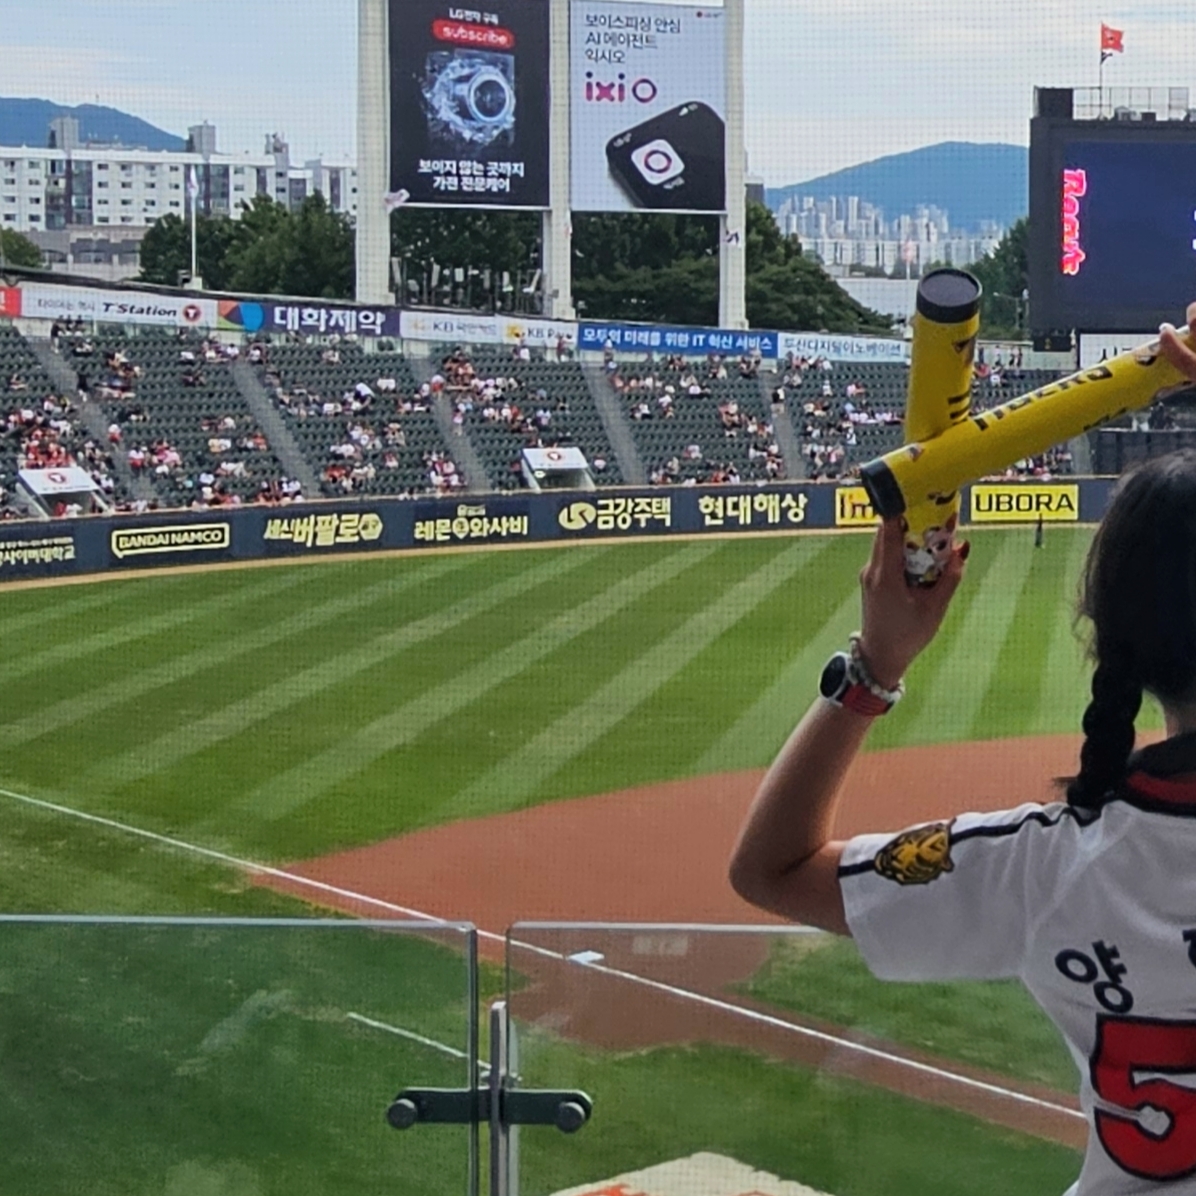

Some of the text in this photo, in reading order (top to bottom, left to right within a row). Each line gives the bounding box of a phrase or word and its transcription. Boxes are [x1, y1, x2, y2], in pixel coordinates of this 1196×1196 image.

[585, 14, 681, 33] 보이스피싱 안심
[442, 25, 508, 45] subscribe
[585, 48, 626, 64] 익시오
[418, 159, 456, 174] 보이지
[274, 306, 386, 334] 대화제약
[583, 329, 621, 344] 모두의
[624, 330, 661, 346] 미래를
[665, 332, 689, 348] 위한
[692, 334, 706, 346] IT
[699, 494, 807, 526] 현대해상
[975, 493, 1075, 512] UBORA
[597, 497, 671, 530] 금강주택
[119, 530, 222, 549] BANDAI NAMCO
